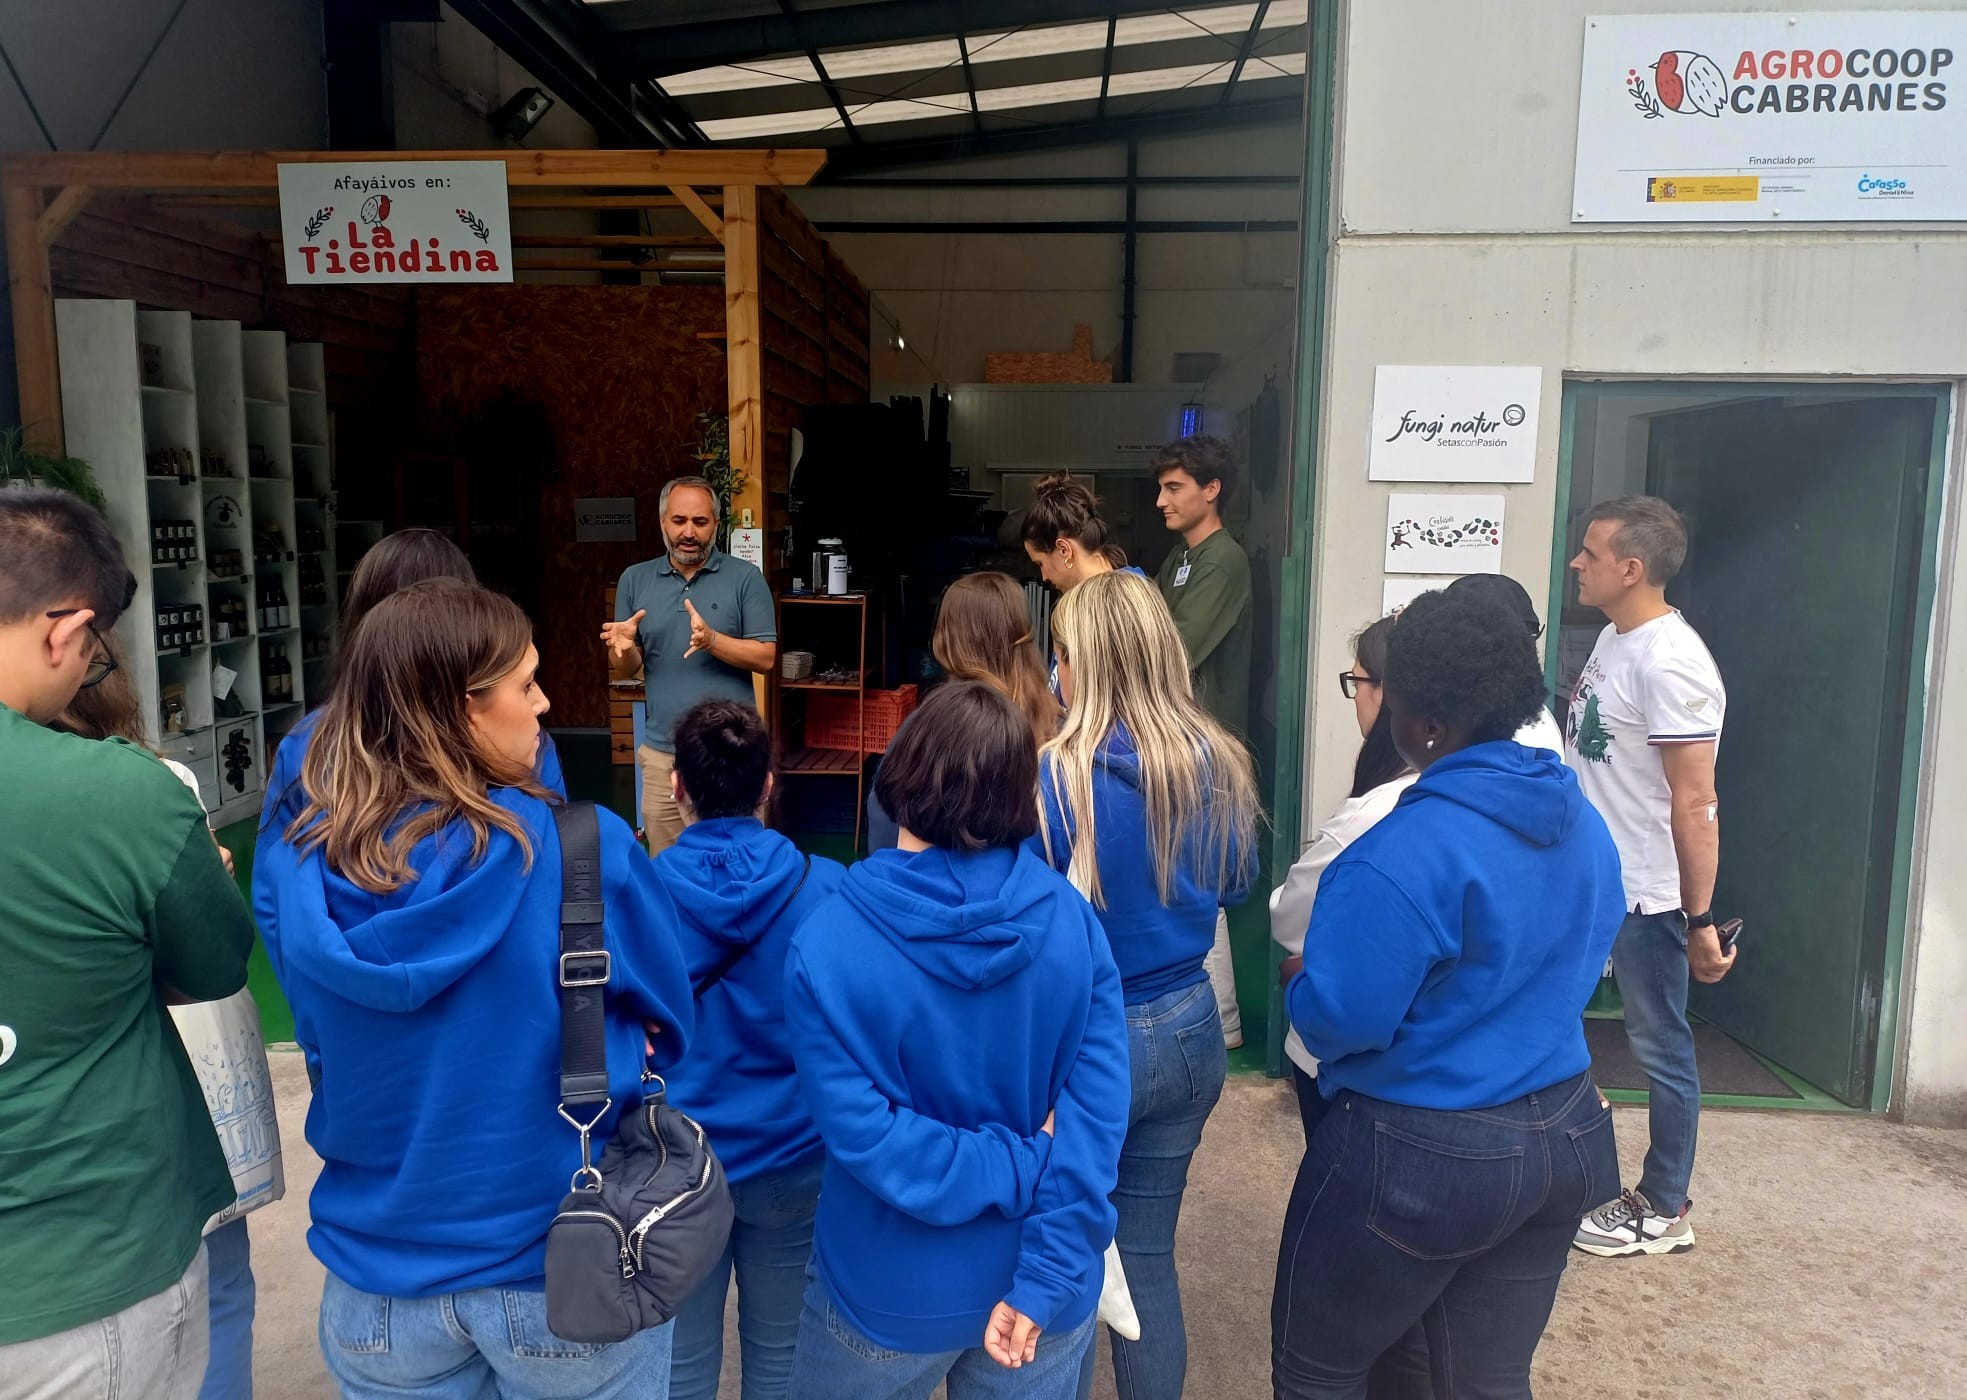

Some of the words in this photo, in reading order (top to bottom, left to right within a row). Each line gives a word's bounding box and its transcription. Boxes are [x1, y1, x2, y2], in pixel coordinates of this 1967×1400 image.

[1733, 48, 1954, 80] AGROCOOP
[1730, 82, 1947, 114] CABRANES
[1749, 156, 1796, 165] Financiado
[1797, 156, 1815, 167] por:
[334, 175, 416, 193] Afayáivos
[425, 178, 452, 189] en:
[1858, 174, 1906, 192] Carasso
[348, 221, 395, 249] La
[298, 237, 500, 275] Tiendina
[1385, 410, 1444, 442] fungi
[1450, 410, 1501, 438] natur
[1437, 437, 1507, 447] SetasconPasión
